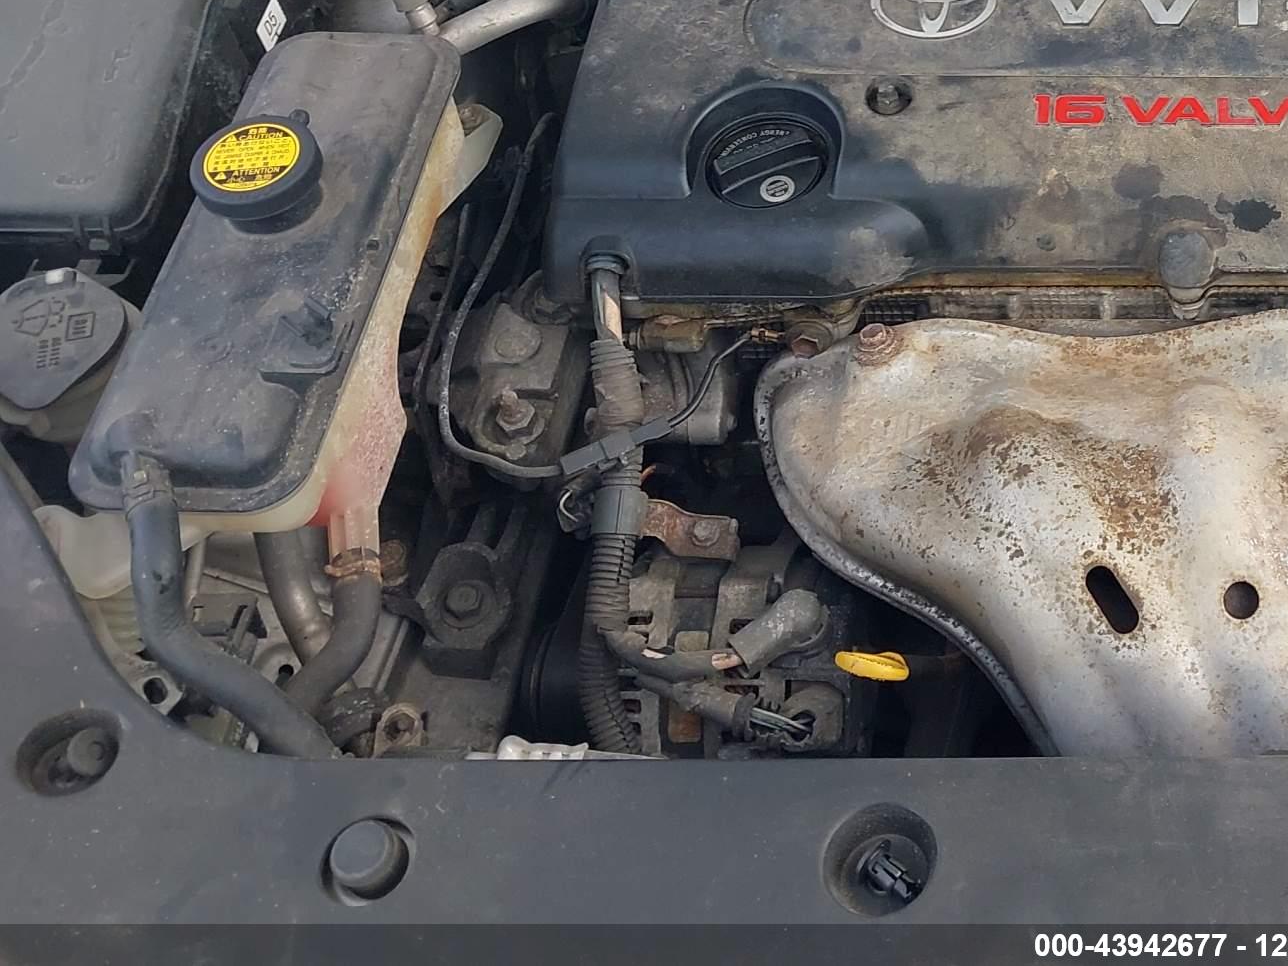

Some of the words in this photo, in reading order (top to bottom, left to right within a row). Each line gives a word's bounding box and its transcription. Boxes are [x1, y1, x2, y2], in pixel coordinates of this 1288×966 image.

[1034, 94, 1106, 126] 16
[239, 132, 284, 141] CAUTION
[232, 166, 281, 177] ATTENTION
